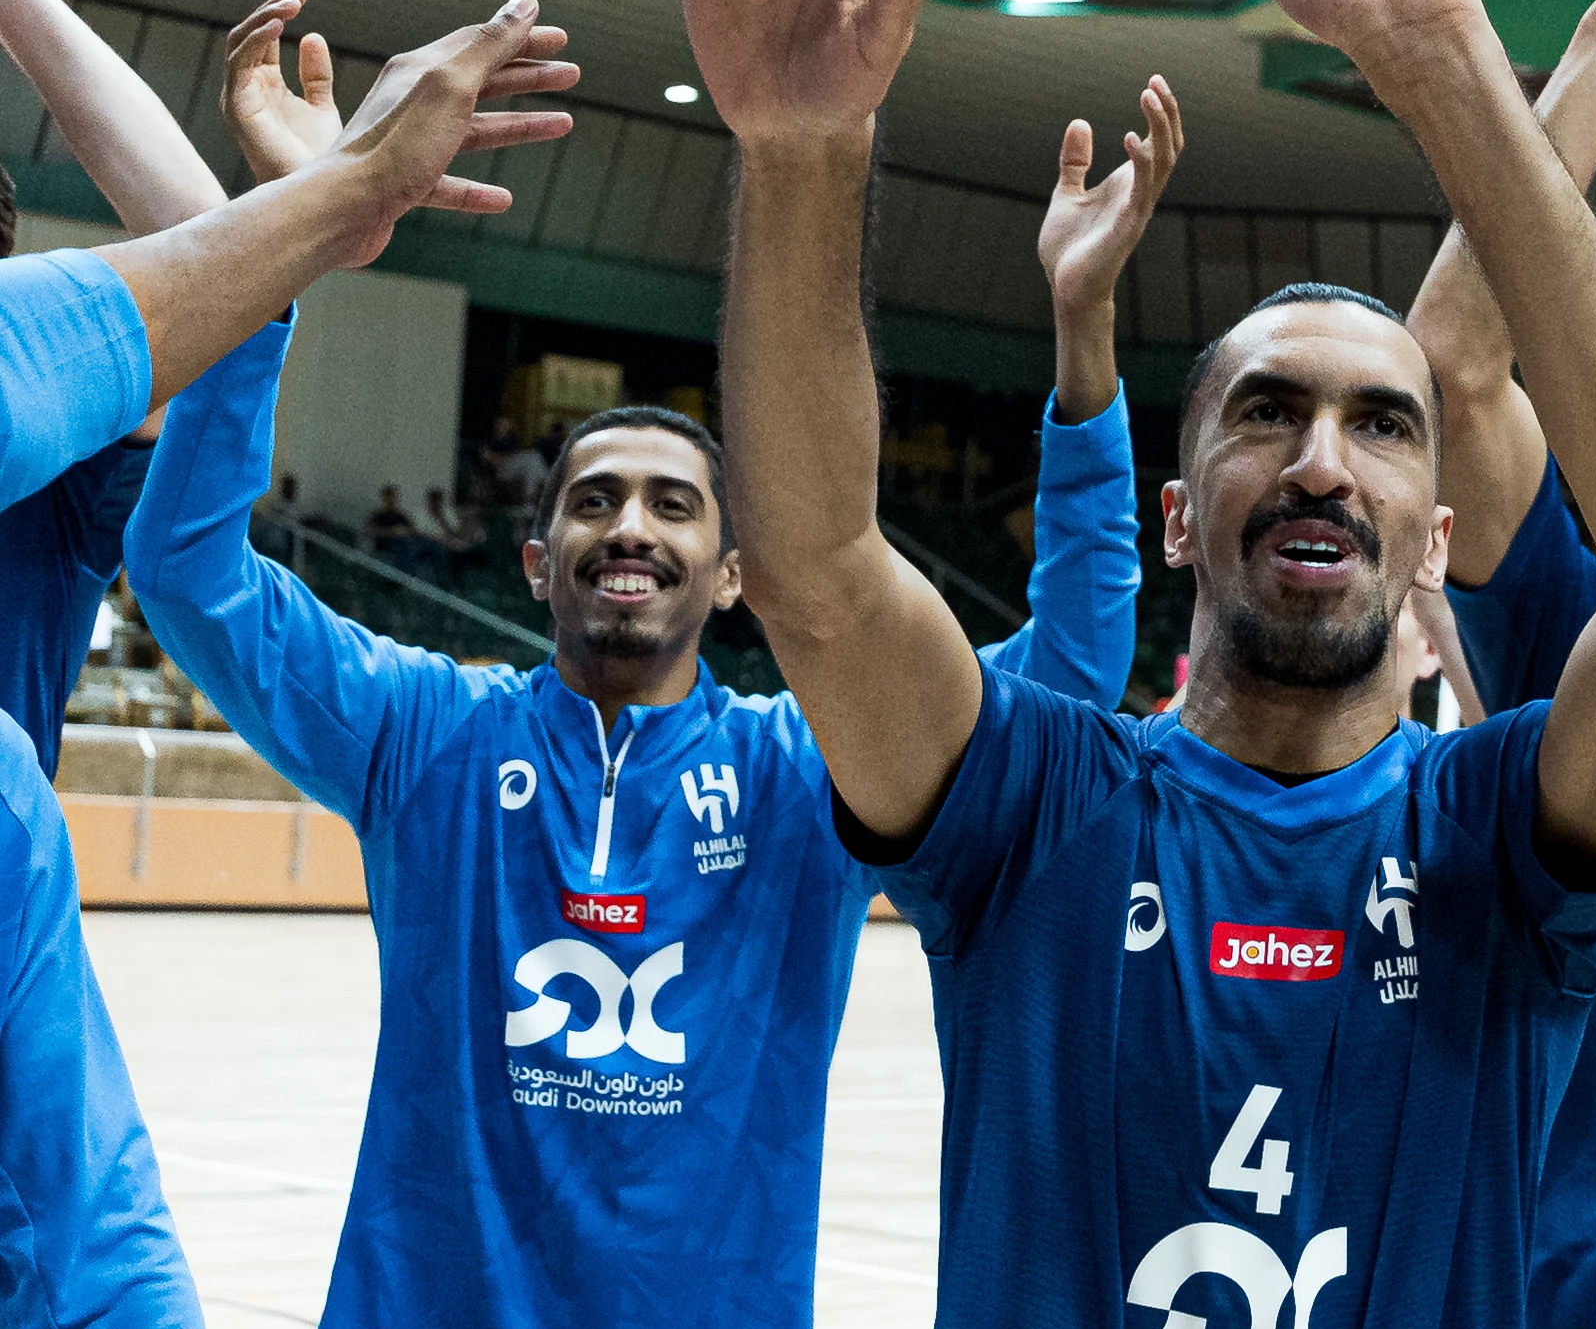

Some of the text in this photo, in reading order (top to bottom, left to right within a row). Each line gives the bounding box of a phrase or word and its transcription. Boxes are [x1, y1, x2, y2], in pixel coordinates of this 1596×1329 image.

[693, 834, 747, 857] ALHILAL
[697, 851, 746, 874] الهلال
[1373, 955, 1420, 981] ALHIL
[593, 1072, 639, 1098] تاون
[638, 1072, 685, 1099] داون
[512, 1087, 683, 1116] audi Downtown
[1208, 1083, 1294, 1215] 4
